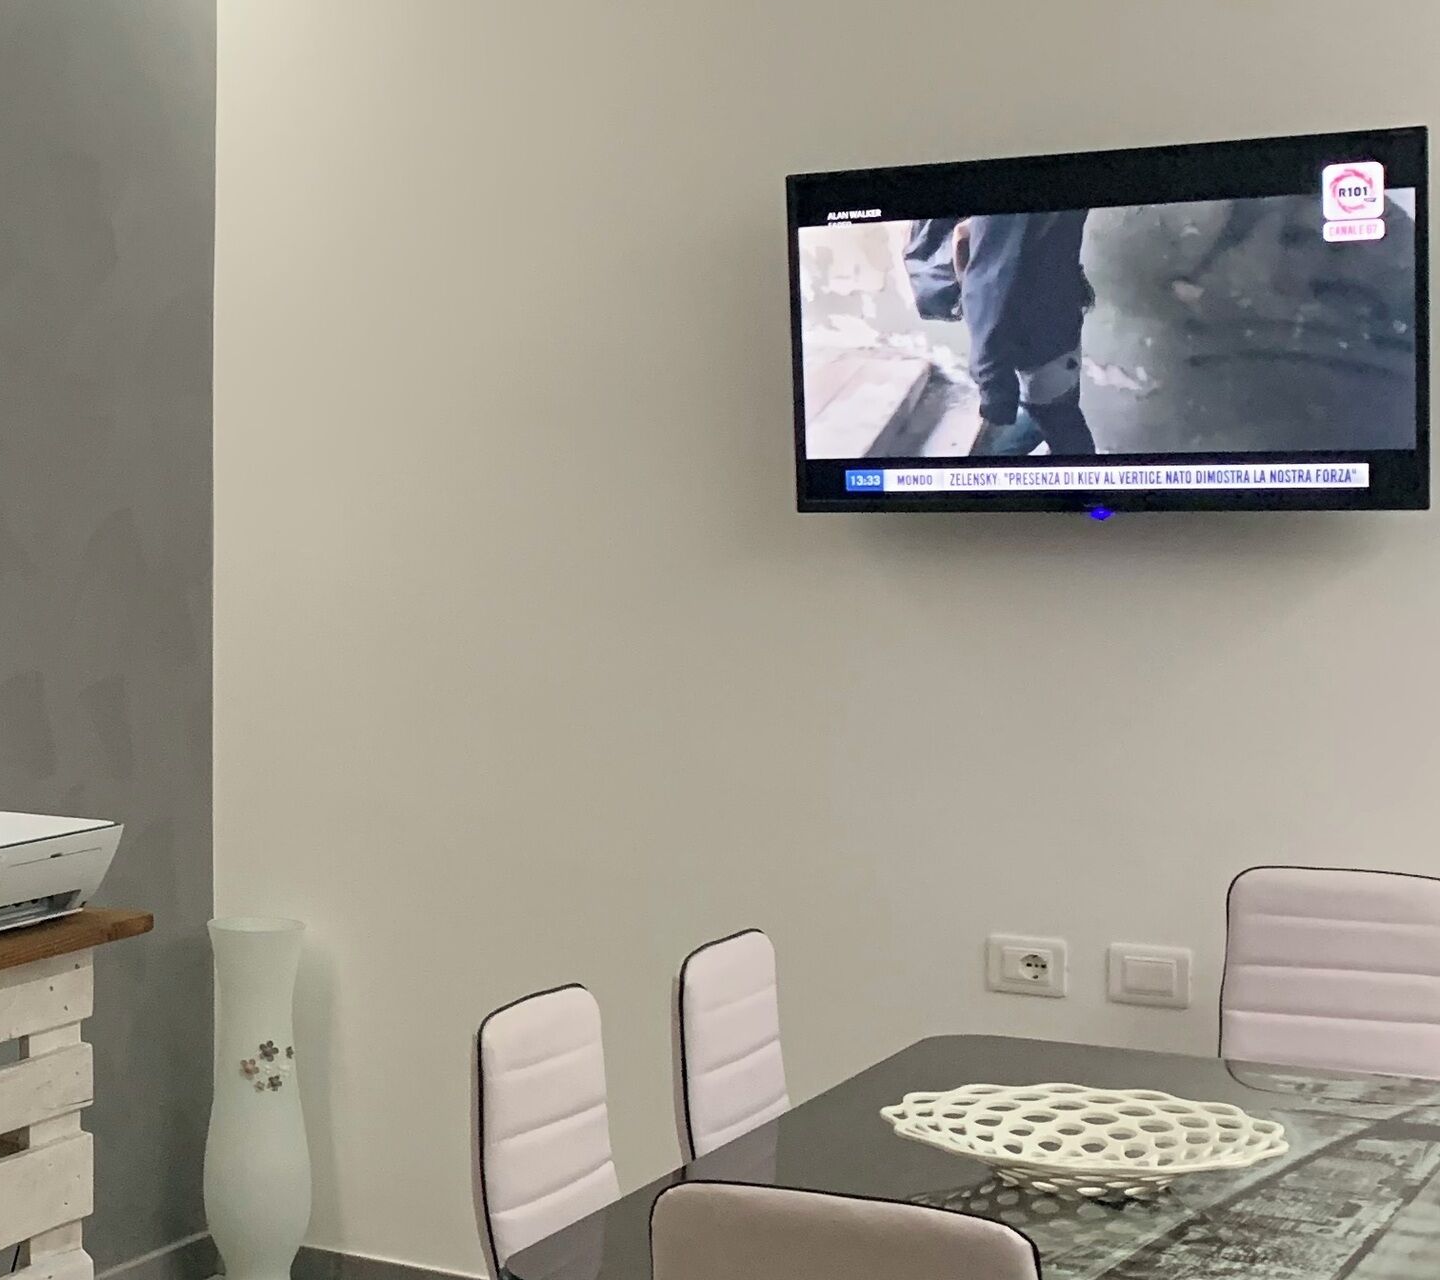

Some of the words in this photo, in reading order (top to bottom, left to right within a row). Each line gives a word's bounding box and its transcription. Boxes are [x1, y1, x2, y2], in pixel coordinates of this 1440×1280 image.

[1338, 186, 1368, 197] R101
[827, 211, 849, 221] ALAN
[849, 208, 882, 219] WALKER
[850, 474, 881, 487] 13:33
[897, 474, 933, 486] MONDO
[1064, 471, 1074, 485] DI
[1078, 471, 1101, 485] KIEV
[1103, 471, 1116, 485] AL
[1119, 470, 1162, 485] VERTICE
[1165, 470, 1192, 484] NATO
[1196, 469, 1250, 484] DIMOSTRA
[1253, 469, 1266, 483] LA
[1269, 468, 1312, 483] NOSTRA
